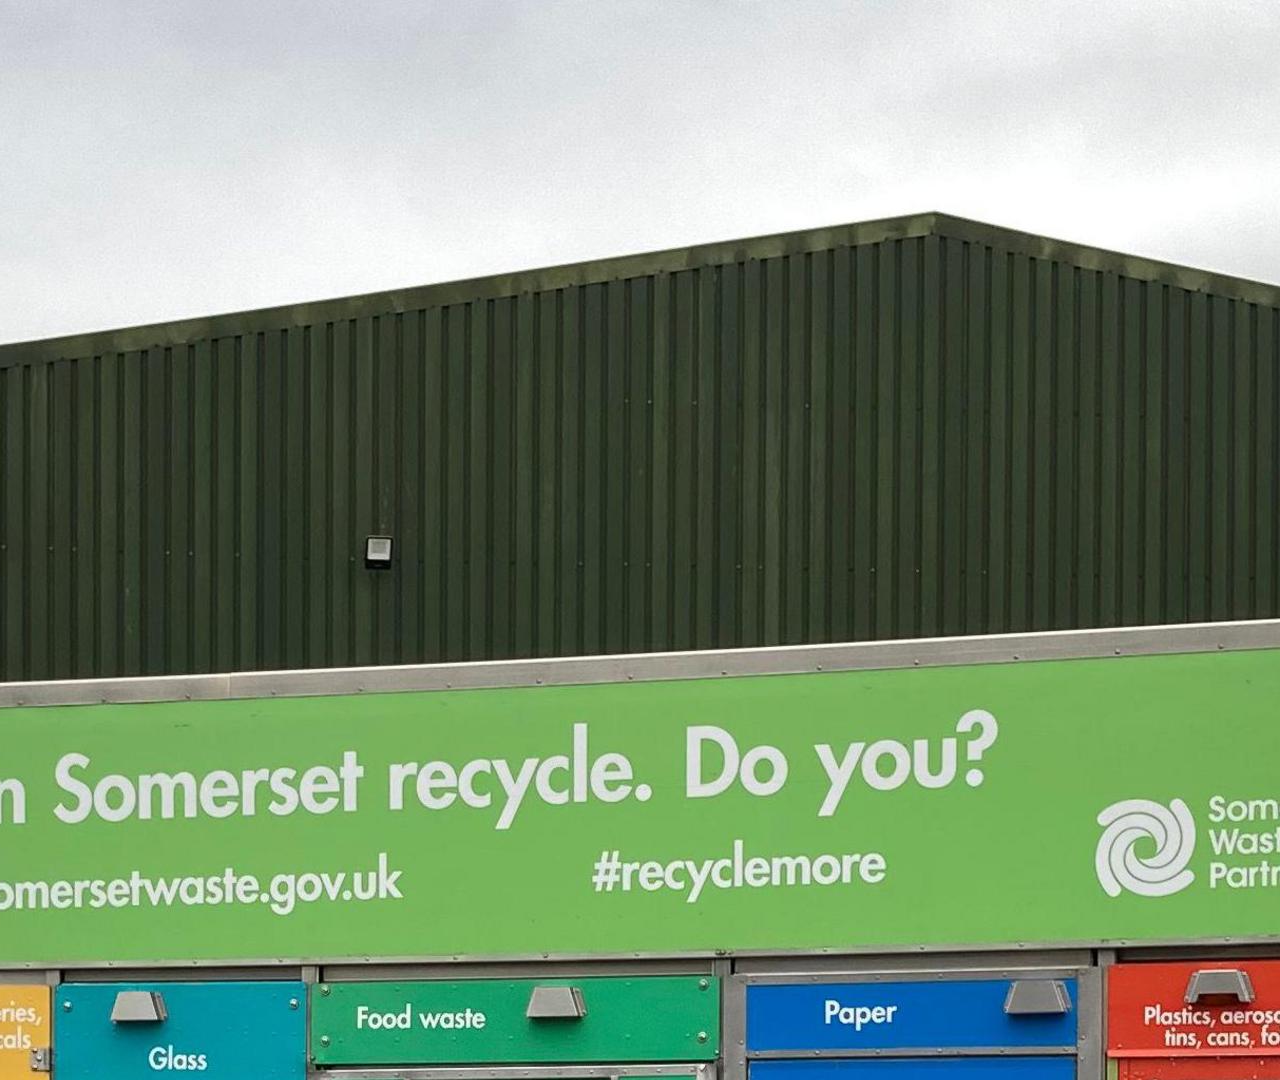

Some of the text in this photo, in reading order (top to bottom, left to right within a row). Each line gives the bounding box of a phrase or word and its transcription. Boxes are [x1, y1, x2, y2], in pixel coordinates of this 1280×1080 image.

[53, 750, 364, 824] Somerset
[389, 722, 652, 830] recycle.
[686, 725, 788, 798] Do
[814, 709, 999, 817] you?
[592, 839, 886, 903] #recyclemore
[357, 1003, 486, 1030] Food waste
[825, 1000, 898, 1031] Paper
[1144, 1004, 1216, 1028] Plastics,
[1164, 1027, 1202, 1049] tins,
[1207, 1032, 1255, 1049] cans,
[148, 1045, 208, 1071] Glass
